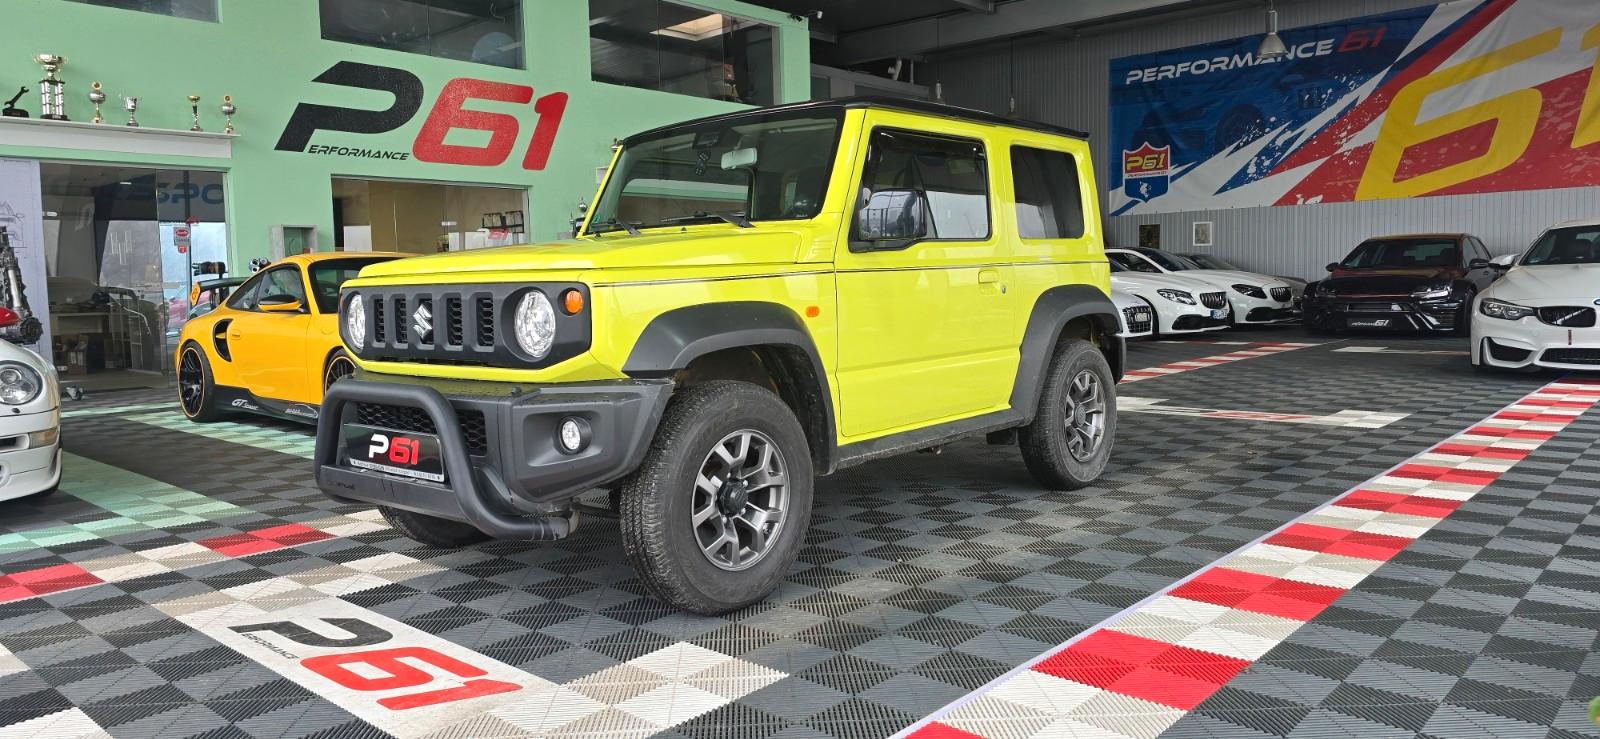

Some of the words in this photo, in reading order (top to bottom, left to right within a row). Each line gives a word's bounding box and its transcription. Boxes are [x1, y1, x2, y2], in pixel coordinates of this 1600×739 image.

[1340, 27, 1387, 53] 61
[274, 60, 568, 171] P61
[308, 144, 411, 161] ERFORMANCE
[1126, 153, 1166, 170] P61
[368, 433, 420, 465] P61
[227, 617, 524, 710] P61
